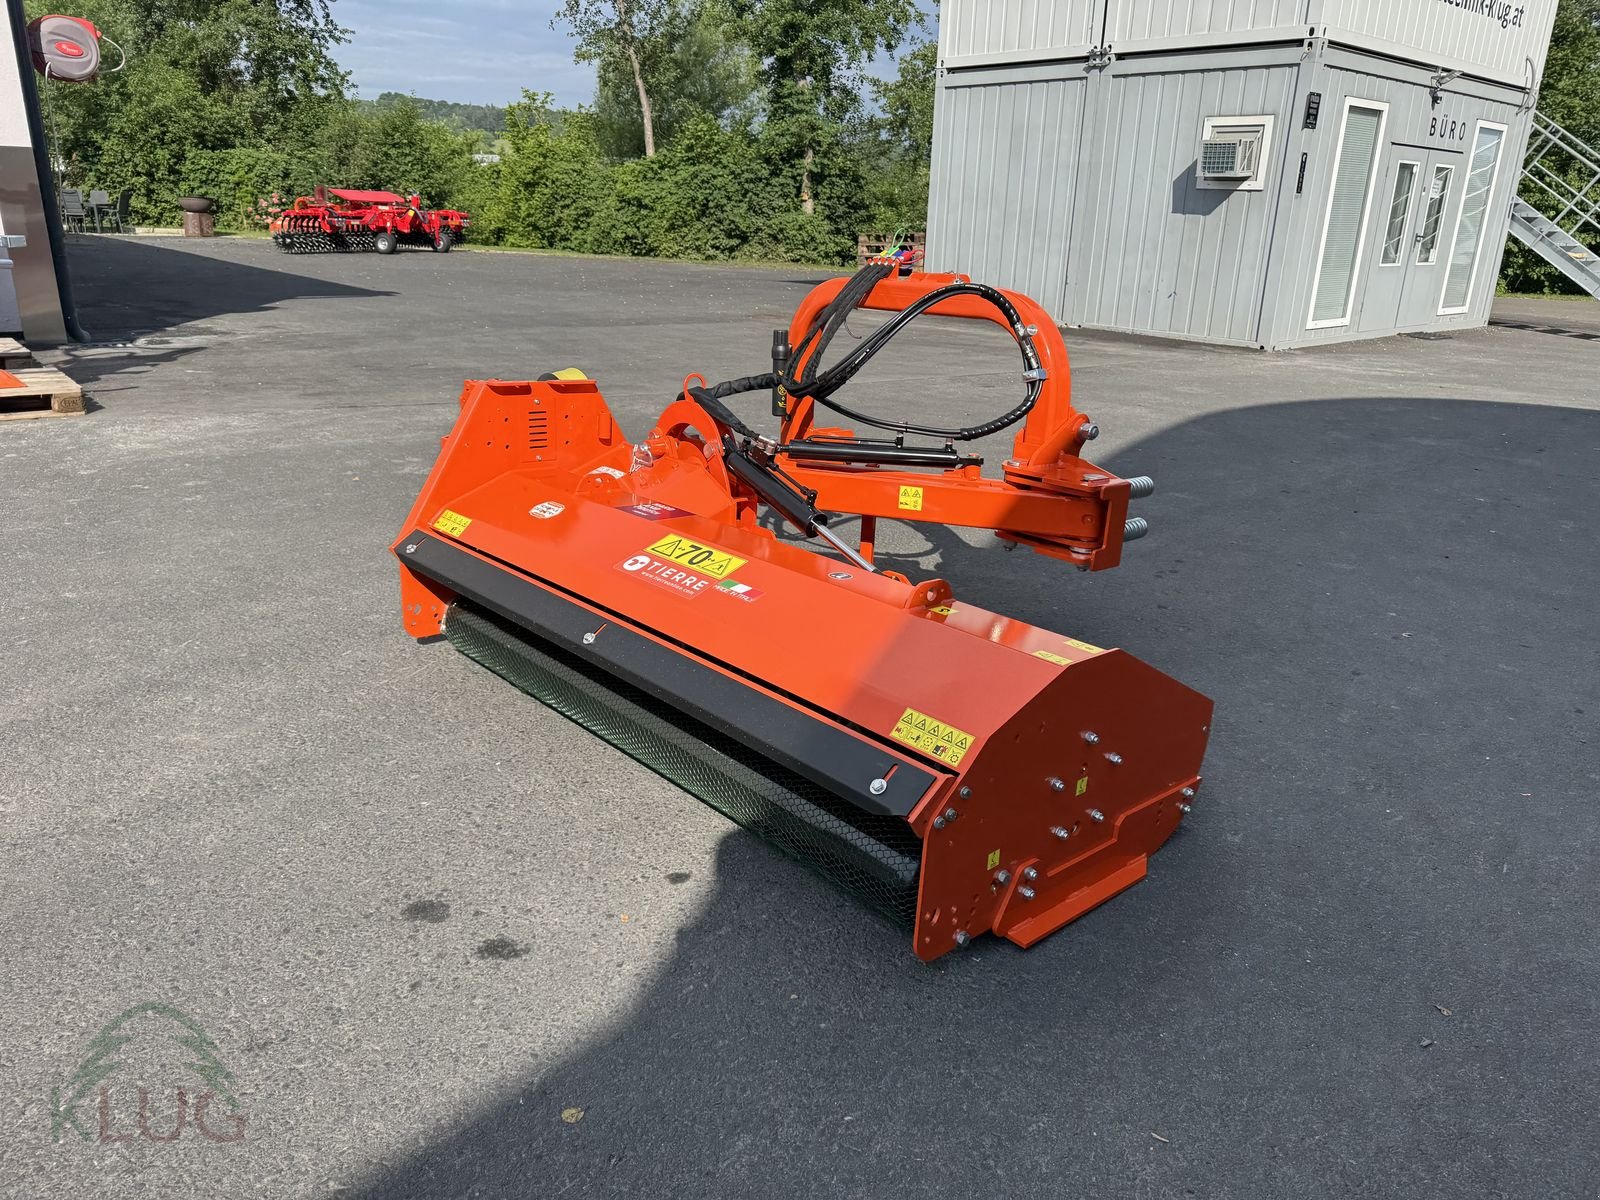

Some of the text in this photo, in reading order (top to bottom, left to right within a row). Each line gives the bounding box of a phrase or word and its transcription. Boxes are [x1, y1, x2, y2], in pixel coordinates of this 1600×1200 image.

[1429, 113, 1466, 141] BÜRO
[674, 544, 714, 566] 70
[647, 561, 709, 591] TIERRE
